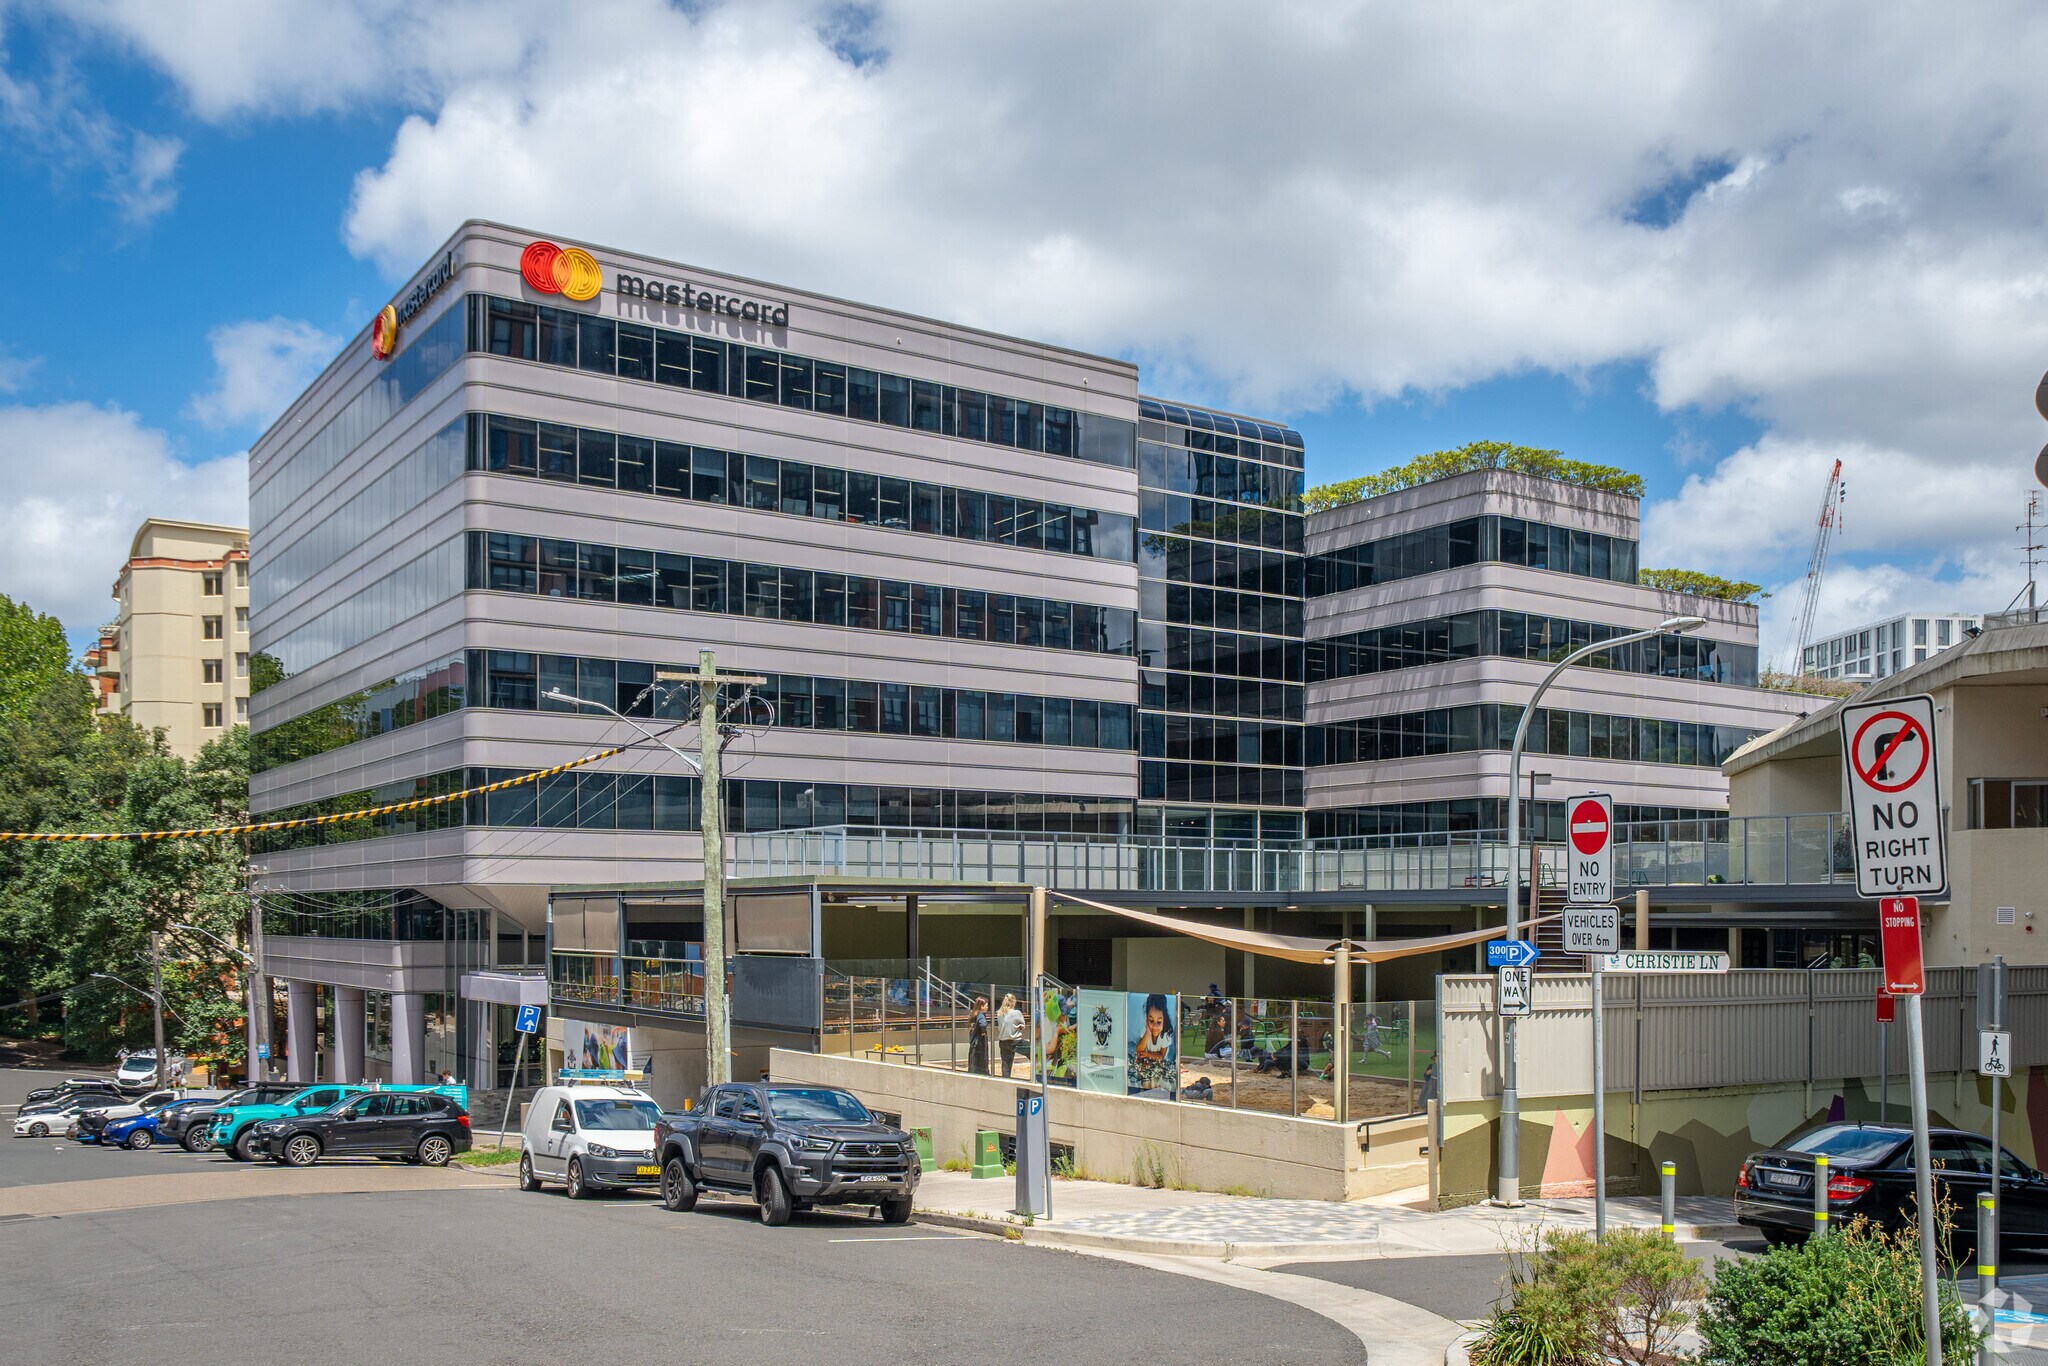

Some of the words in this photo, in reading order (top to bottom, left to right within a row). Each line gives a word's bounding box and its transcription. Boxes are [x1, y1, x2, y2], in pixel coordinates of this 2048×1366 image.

[617, 273, 789, 327] mastercard
[1872, 801, 1919, 831] NO
[1866, 837, 1930, 859] RIGHT
[1579, 861, 1600, 877] NO
[1870, 865, 1932, 886] TURN
[1573, 882, 1607, 896] ENTRY
[1893, 901, 1905, 913] NO
[1567, 914, 1614, 928] VEHICLES
[1885, 916, 1915, 928] STOPPING
[1571, 932, 1593, 946] OVER
[1595, 934, 1610, 947] 6m
[1489, 946, 1506, 955] 300
[1625, 953, 1696, 970] CHRISTIE
[1700, 955, 1720, 970] LN
[1504, 971, 1528, 983] ONE
[1503, 986, 1527, 998] WAY
[523, 1008, 535, 1018] P
[1031, 1100, 1039, 1113] P
